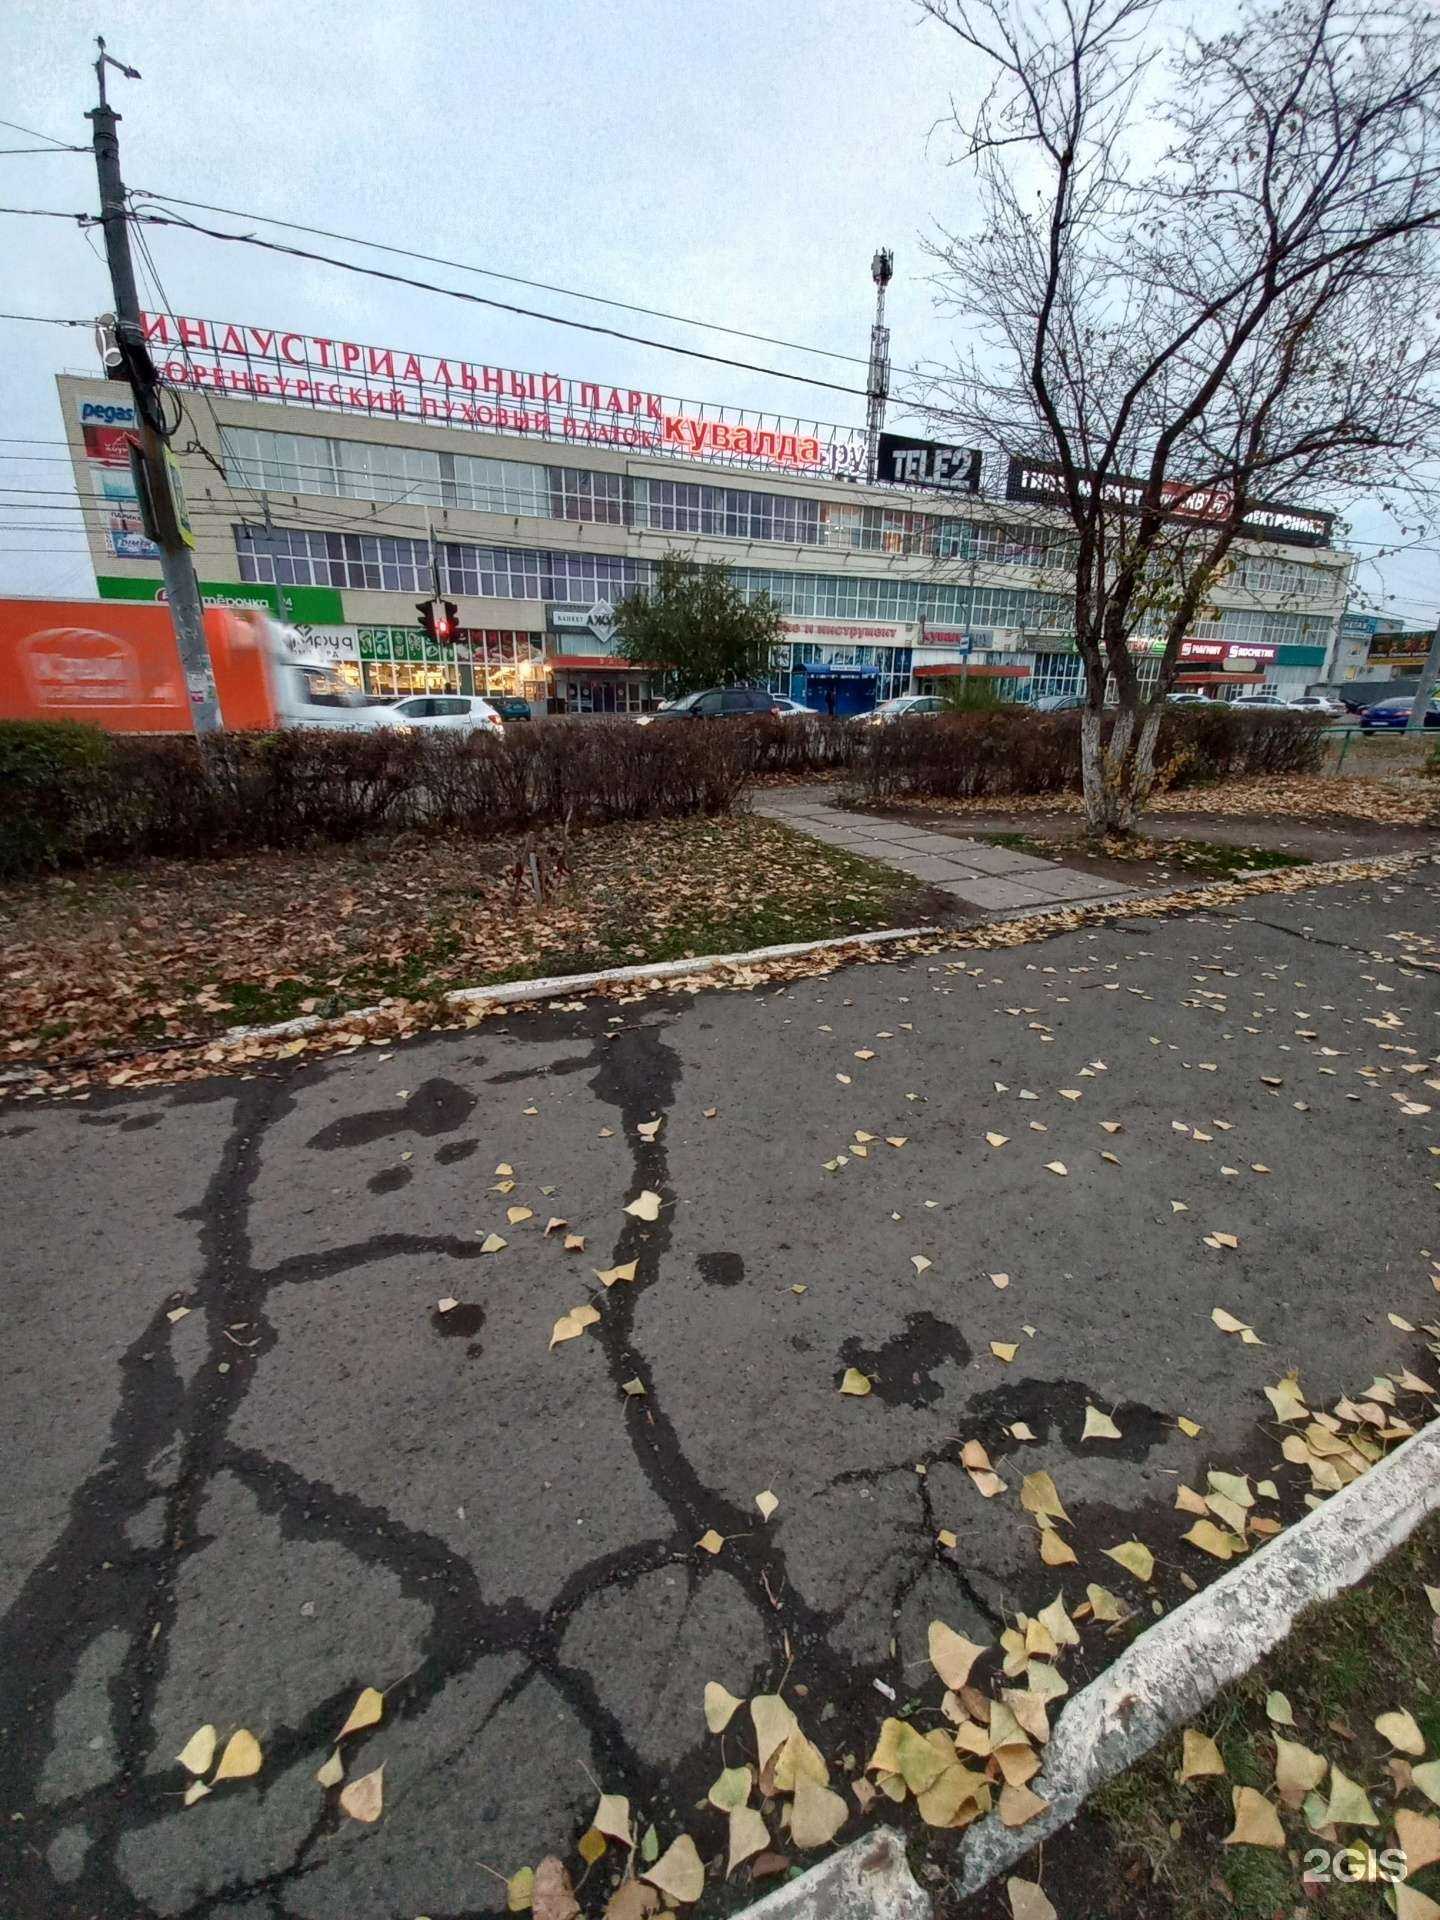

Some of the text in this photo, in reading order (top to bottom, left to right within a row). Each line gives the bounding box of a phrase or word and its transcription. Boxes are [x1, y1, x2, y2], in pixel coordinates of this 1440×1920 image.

[140, 311, 662, 420] ИНДУСТРИАЛЬНЫЙ ПАРК
[82, 403, 133, 424] pegas
[422, 397, 549, 433] ПУХОВЫЙ
[892, 448, 972, 490] TELE2
[1242, 509, 1326, 536] ЛЕКТРОНИКИ
[202, 594, 269, 608] тёрочка
